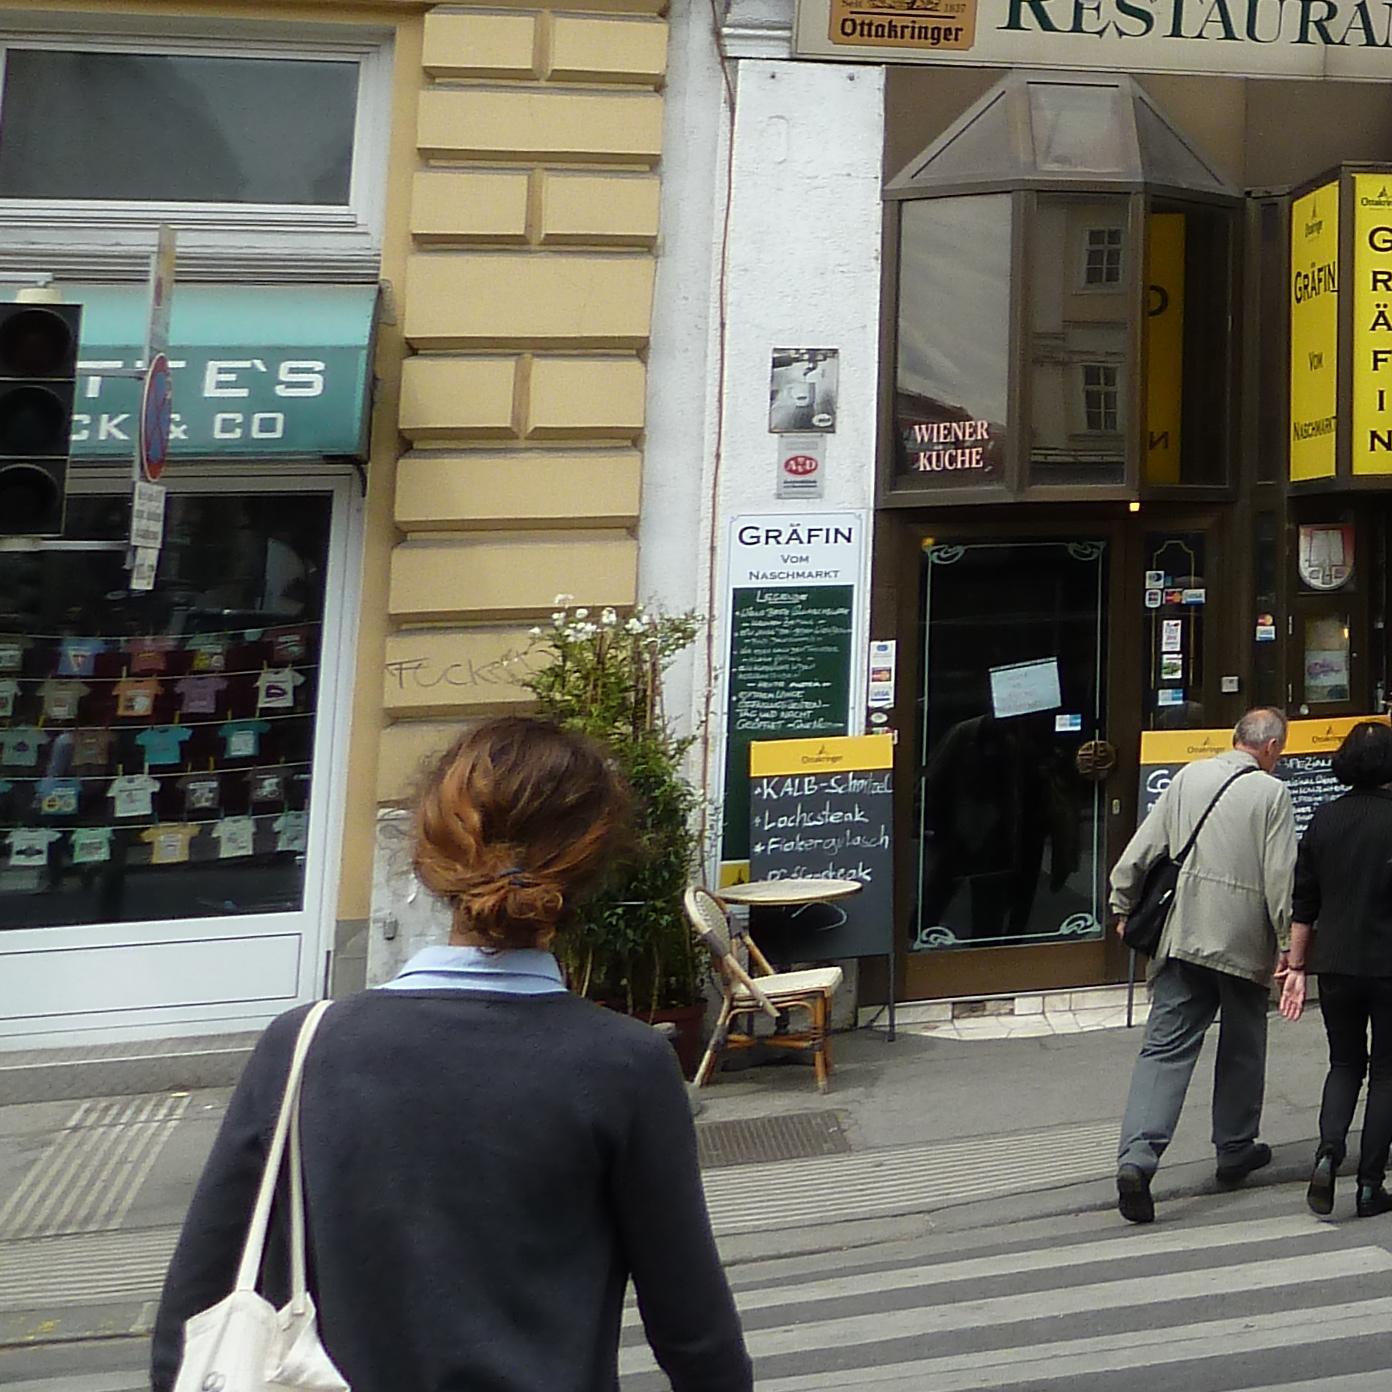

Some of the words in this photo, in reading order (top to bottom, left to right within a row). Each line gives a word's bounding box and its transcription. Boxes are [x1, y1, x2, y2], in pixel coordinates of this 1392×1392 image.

[840, 18, 963, 46] Ottakringer
[1294, 260, 1336, 304] GRÄFIN
[213, 412, 285, 440] CO
[913, 420, 989, 444] WIENER
[1293, 416, 1337, 441] NASCHMARKT
[918, 445, 984, 472] KÜCHE
[738, 523, 852, 546] GRÄFIN
[780, 554, 809, 564] VOM
[749, 570, 840, 581] NASCHMARKT
